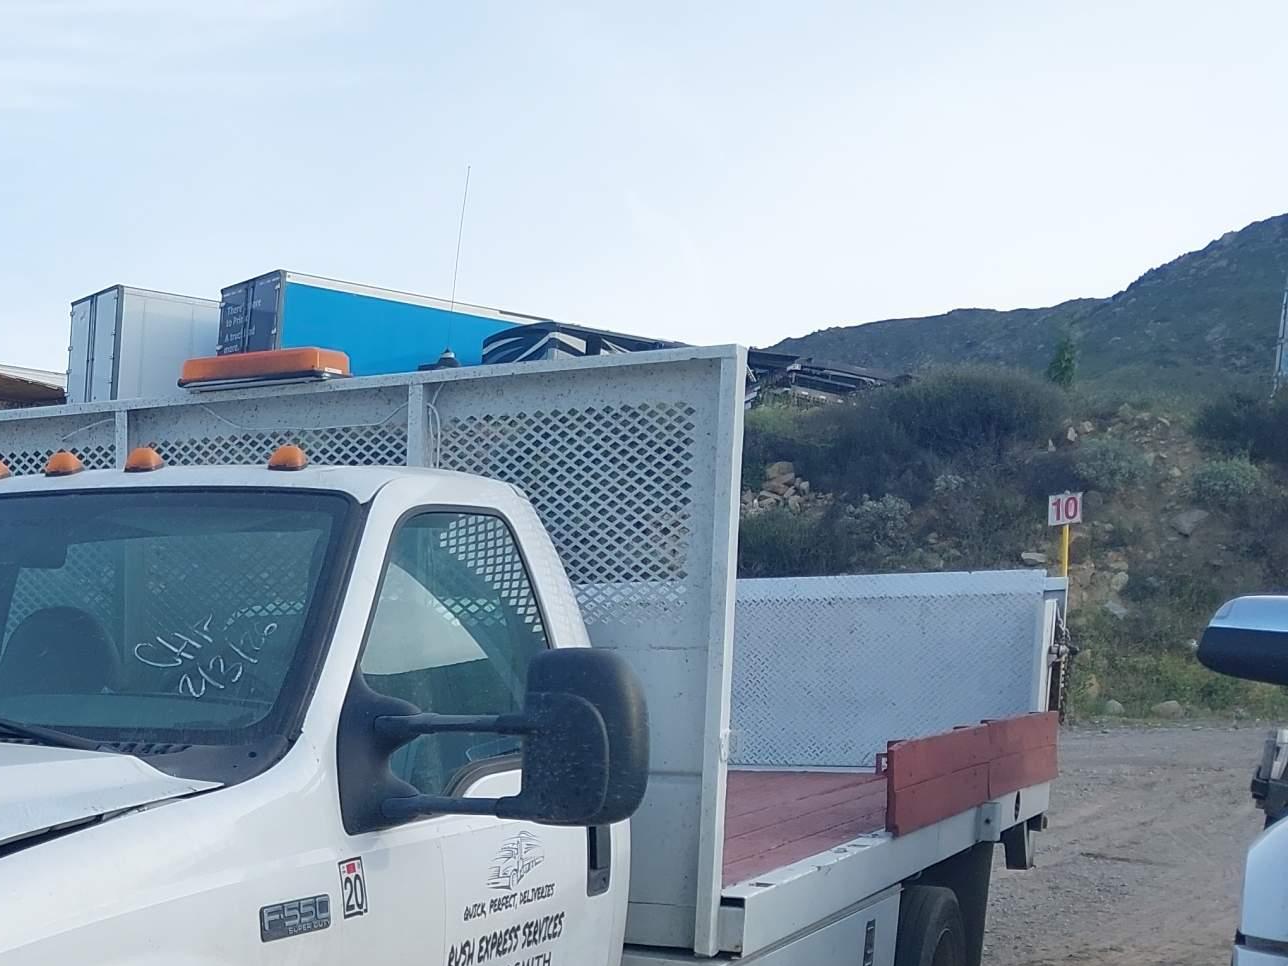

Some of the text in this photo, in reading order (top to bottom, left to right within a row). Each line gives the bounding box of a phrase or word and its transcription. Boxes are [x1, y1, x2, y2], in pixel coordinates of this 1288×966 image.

[1052, 496, 1078, 520] 10
[344, 873, 365, 912] 20
[519, 883, 556, 905] DELIVERIES
[288, 924, 312, 935] SUPER
[477, 923, 522, 964] EXPRESS
[521, 911, 566, 949] SERVICES
